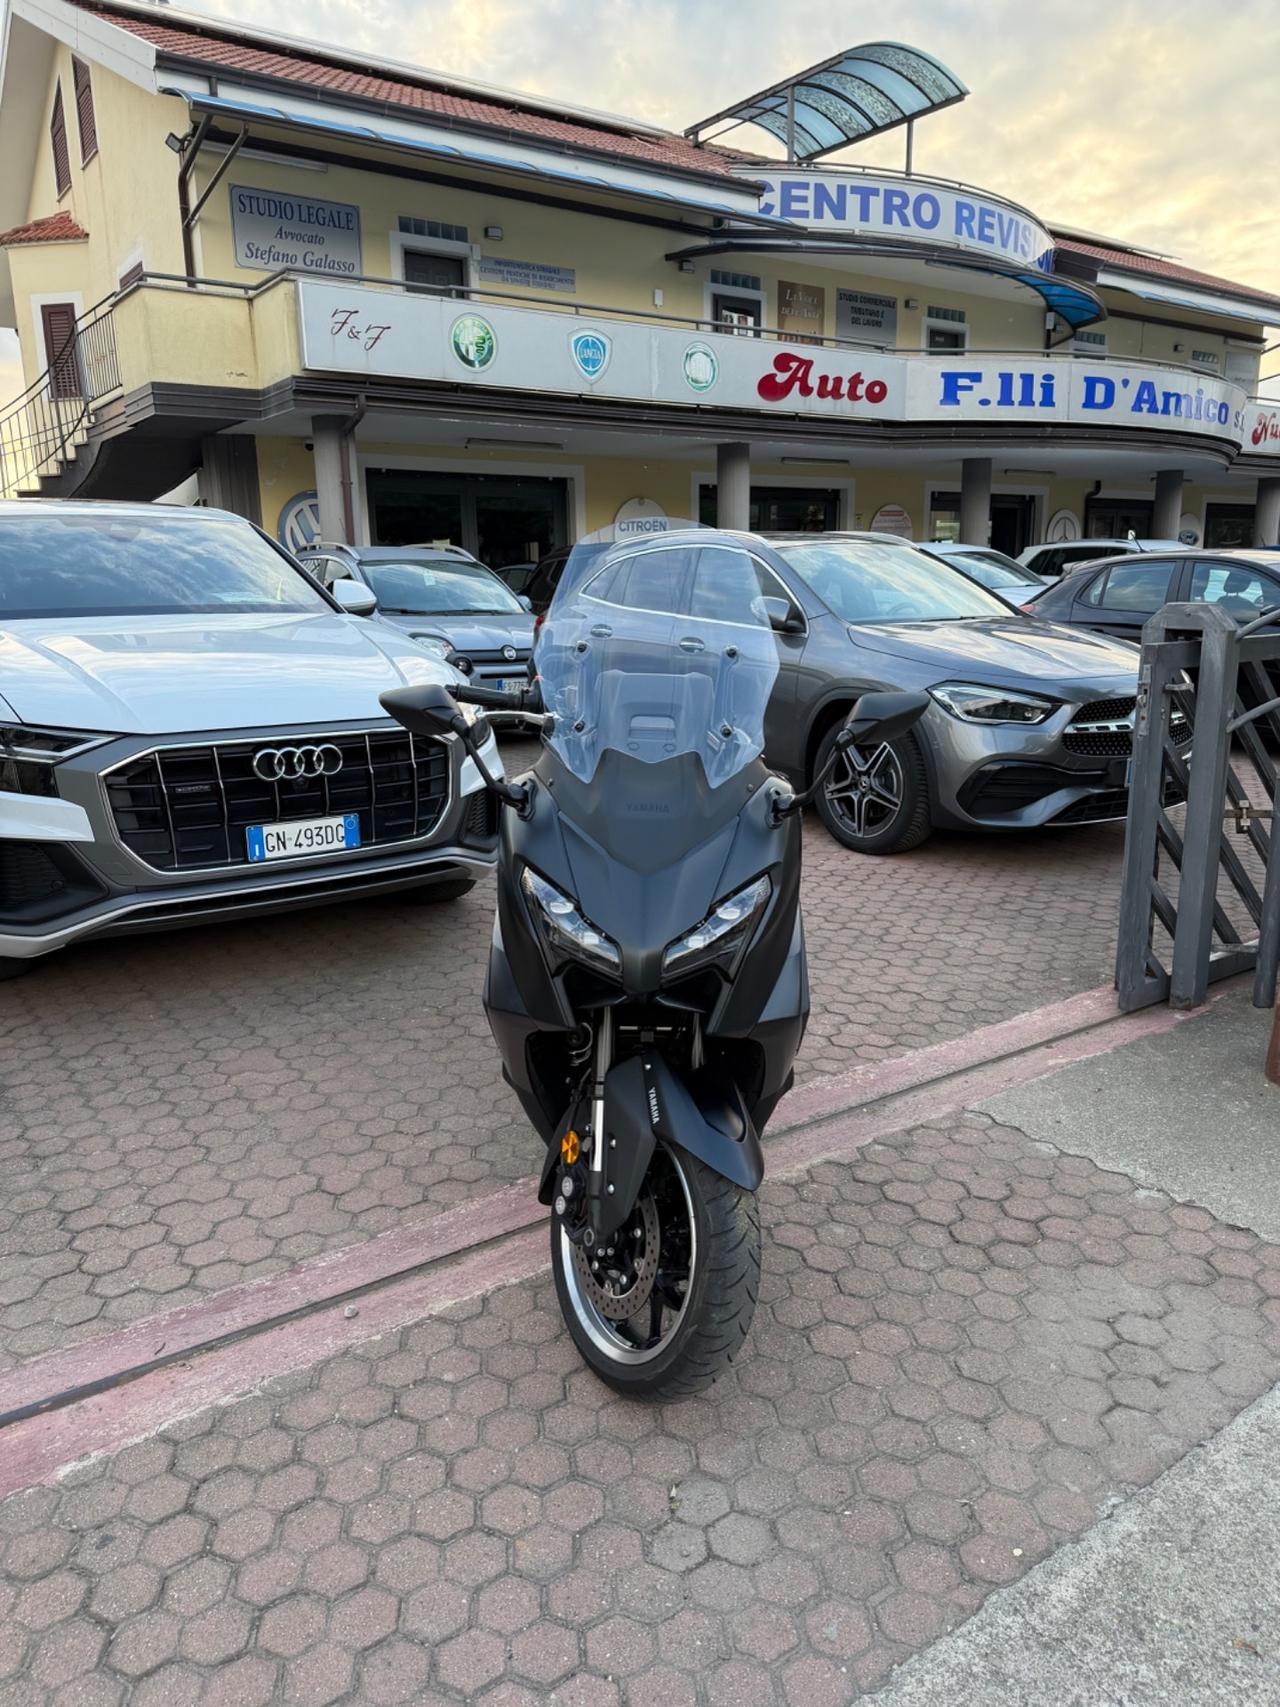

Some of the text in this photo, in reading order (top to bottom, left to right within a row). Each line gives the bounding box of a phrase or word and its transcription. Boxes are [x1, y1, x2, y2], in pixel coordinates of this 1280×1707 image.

[238, 193, 354, 231] STUDIO LEGALE
[274, 226, 325, 246] Avvocato
[245, 242, 355, 273] Stefano Galasso
[839, 292, 858, 303] STUDIO
[757, 352, 888, 404] Auto
[939, 371, 1056, 408] F.lli
[1082, 376, 1229, 425] D'Amico
[1251, 412, 1280, 446] Nu
[618, 519, 667, 532] CITROËN
[265, 831, 287, 853] GN
[294, 823, 345, 848] 493DG
[648, 1086, 660, 1125] YAMAHA
